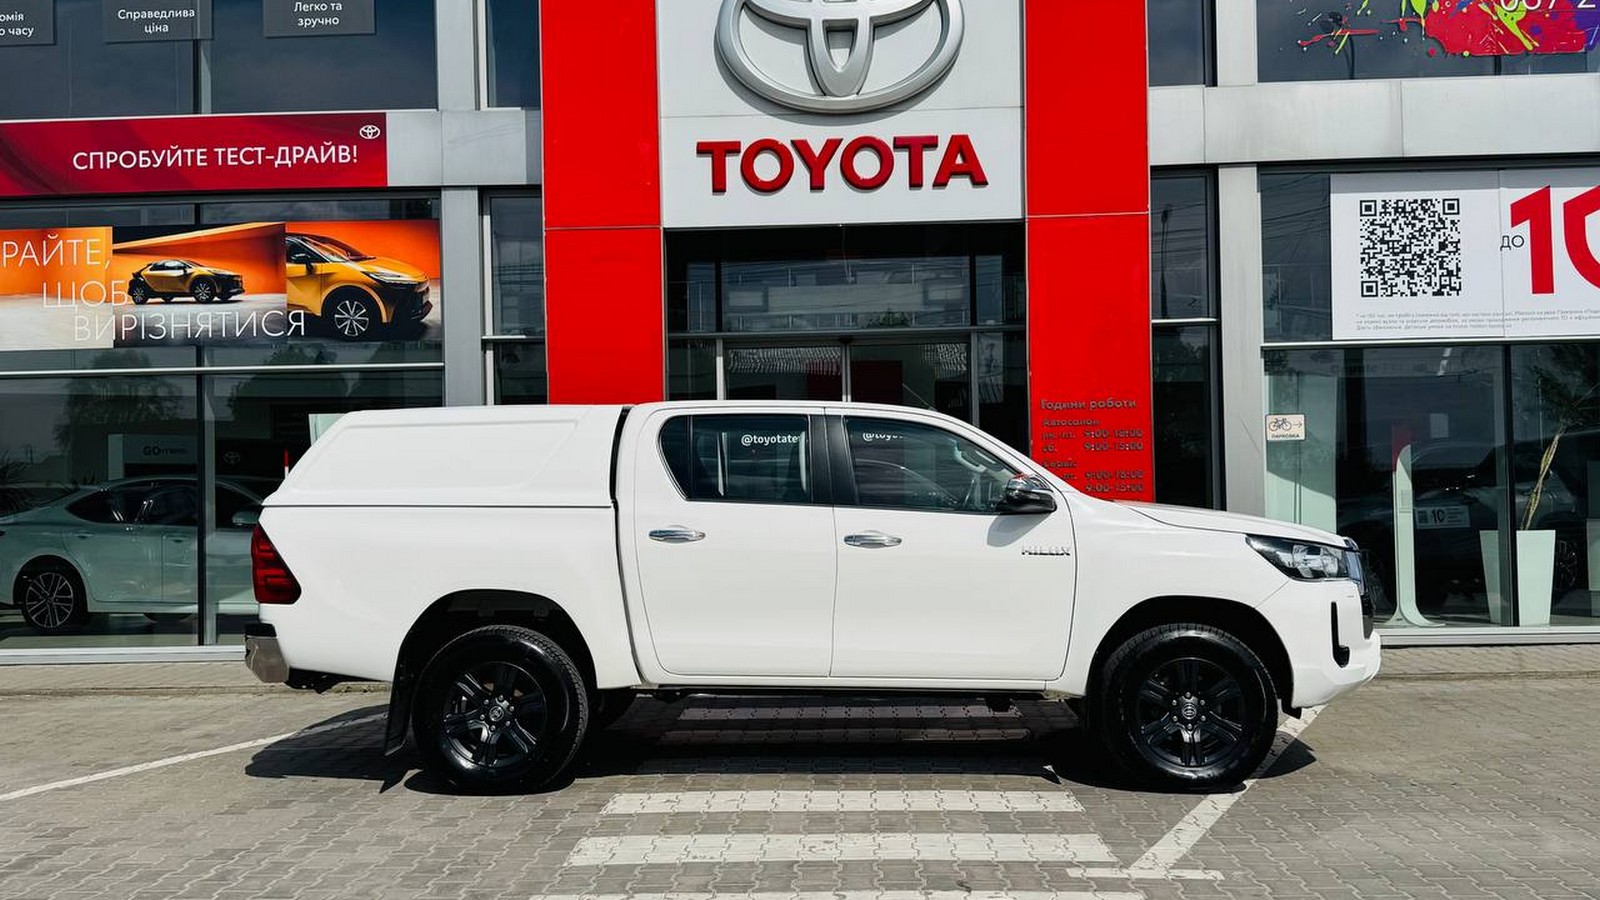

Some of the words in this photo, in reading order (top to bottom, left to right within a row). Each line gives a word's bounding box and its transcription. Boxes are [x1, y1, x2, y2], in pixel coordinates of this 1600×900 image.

[294, 1, 328, 13] Легко
[331, 2, 343, 12] та
[0, 11, 24, 22] омія
[118, 8, 195, 21] Справедлива
[144, 23, 169, 34] ціна
[298, 16, 340, 28] зручно
[8, 27, 34, 38] часу
[73, 144, 208, 171] СПРОБУЙТЕ
[213, 140, 359, 168] ТЕСТ-ДРАЙВ!
[696, 134, 989, 193] TOYOTA
[2, 233, 111, 269] РАЙТЕ,
[42, 280, 128, 311] ЩОБ
[73, 309, 306, 342] ВИРІЗНЯТИСЯ
[1041, 399, 1086, 411] Години
[1090, 397, 1136, 410] роботи
